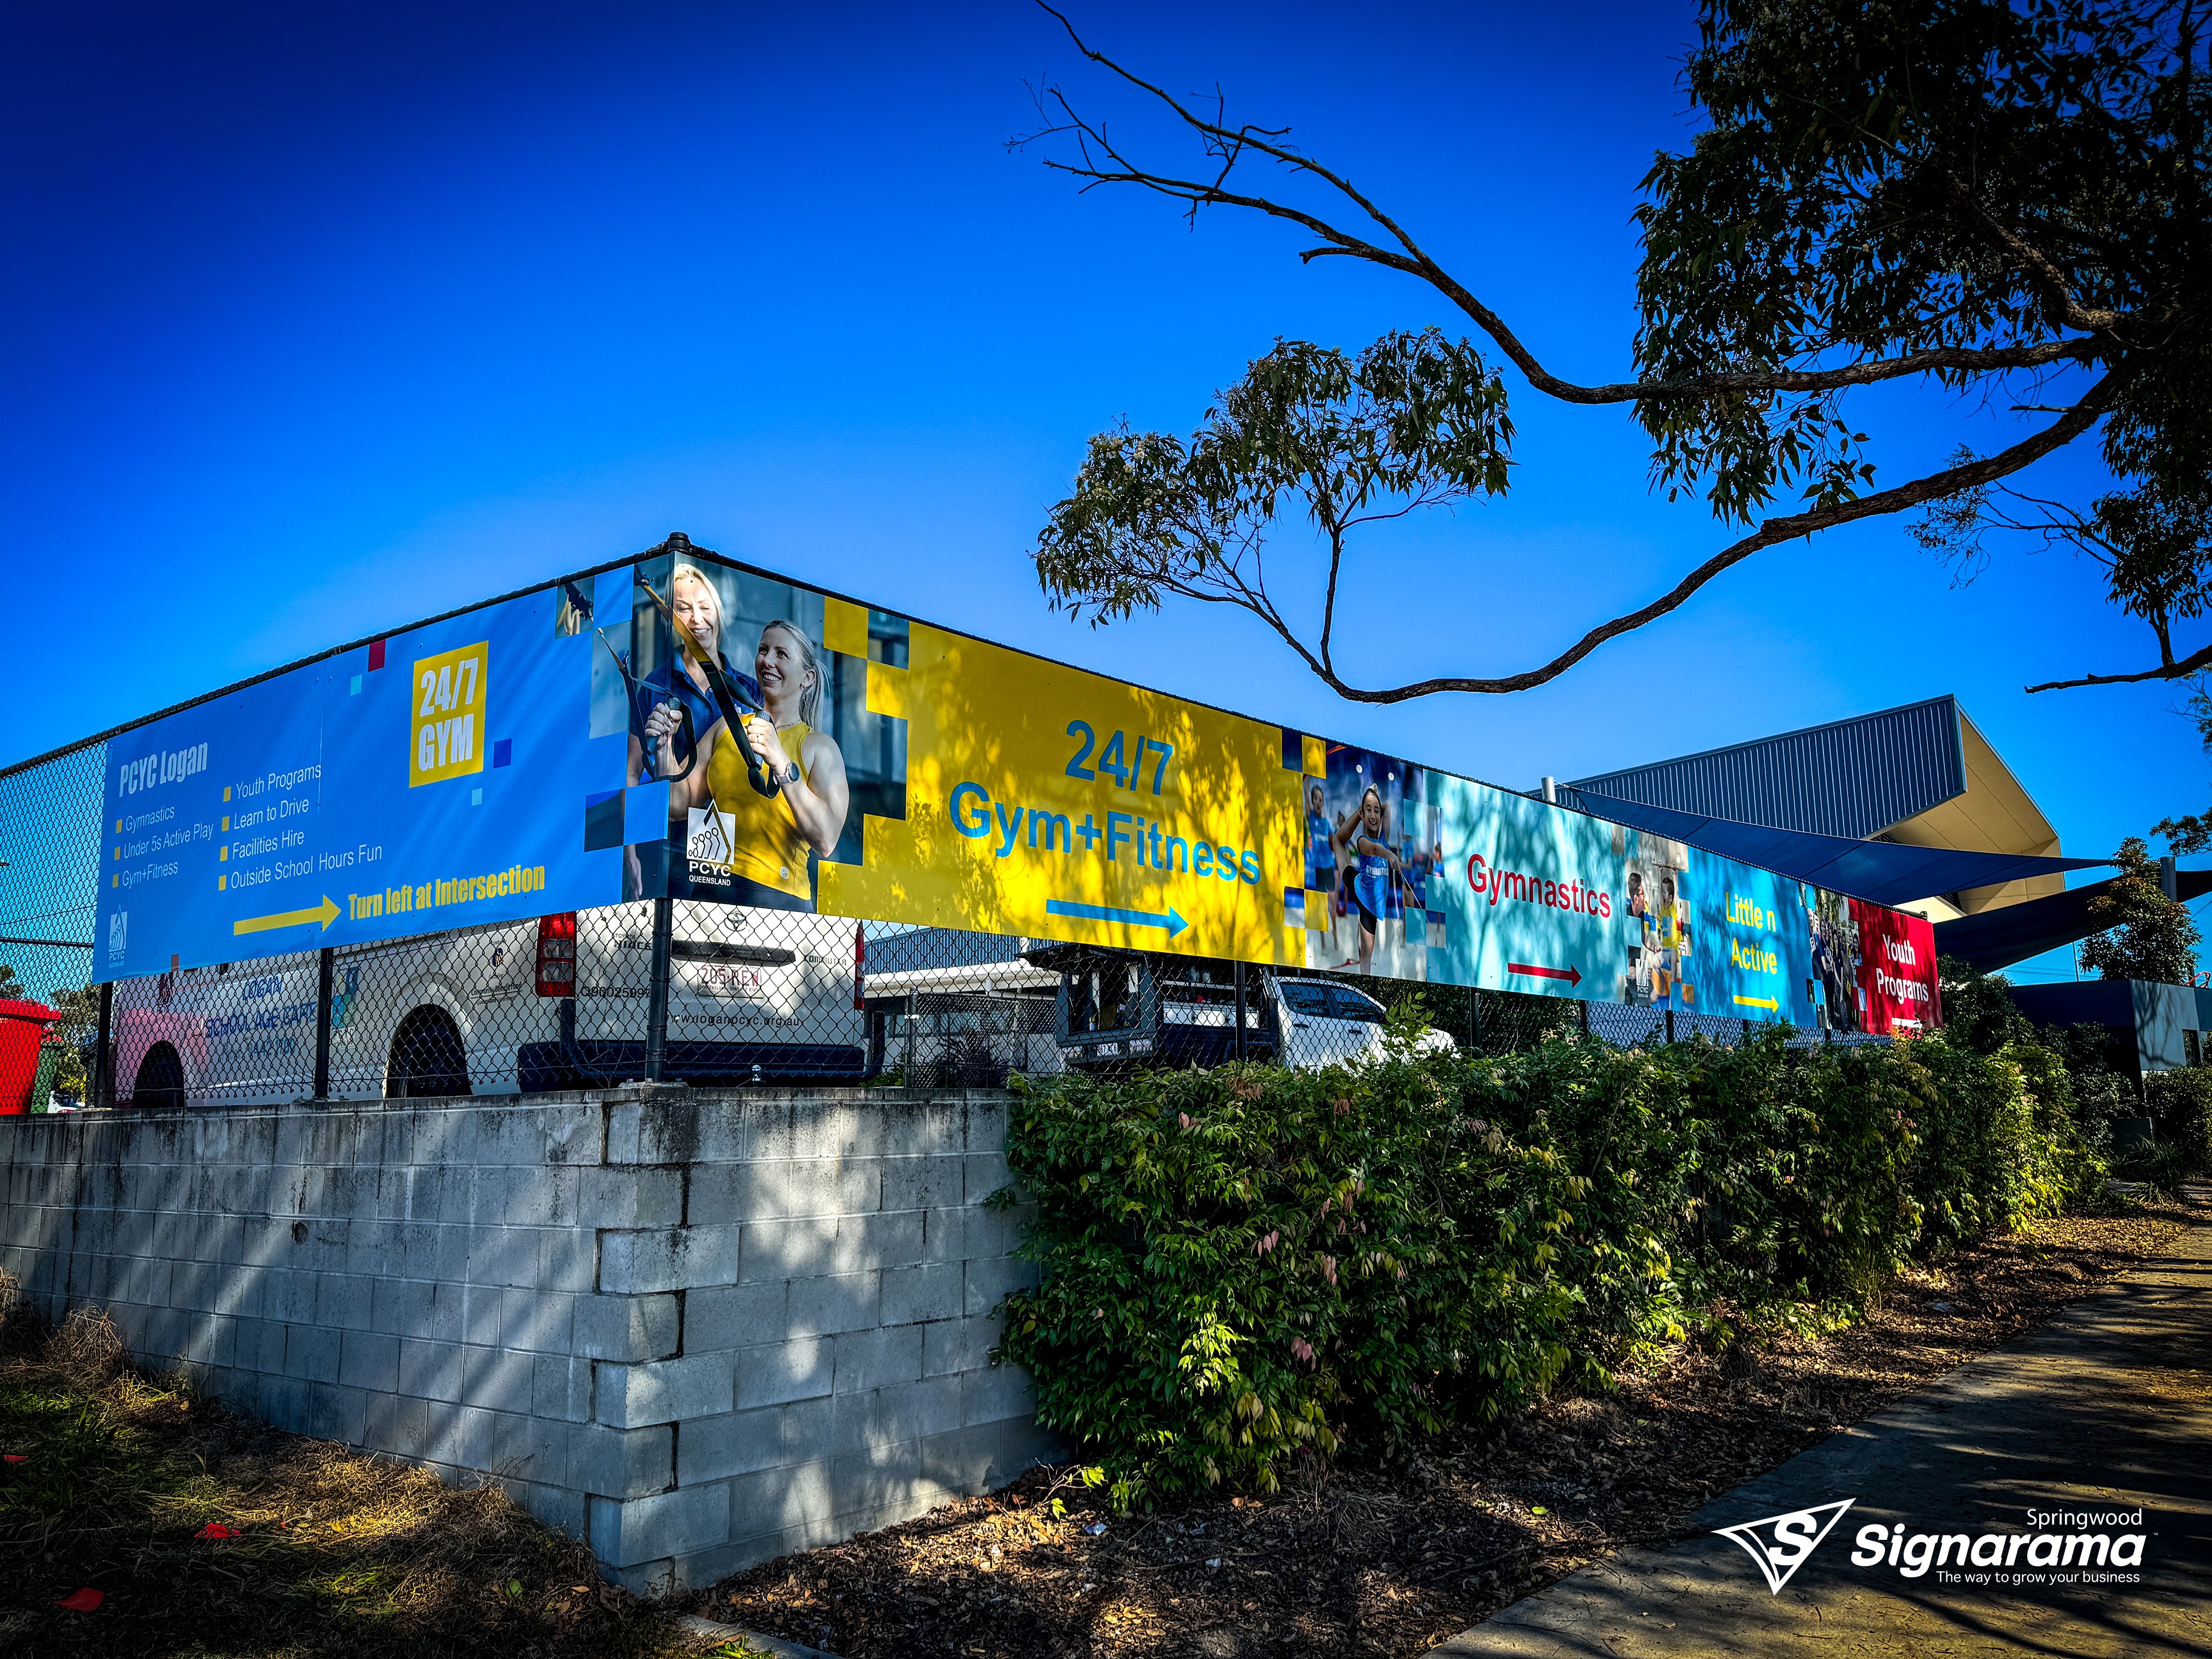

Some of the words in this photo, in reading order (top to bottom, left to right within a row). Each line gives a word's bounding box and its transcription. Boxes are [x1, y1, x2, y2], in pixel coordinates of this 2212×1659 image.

[420, 657, 478, 716] 24/7
[418, 713, 474, 771] GYM
[1065, 720, 1173, 796] 24/7
[119, 754, 157, 797] PCYC
[160, 742, 208, 784] Logan
[236, 780, 264, 799] Youth
[268, 765, 321, 792] Programs
[126, 806, 174, 832] Gymnastics
[234, 811, 263, 829] Learn
[267, 806, 276, 821] to
[280, 799, 309, 817] Drive
[124, 839, 148, 859] Under
[151, 836, 162, 852] 5s
[163, 829, 190, 848] Active
[193, 823, 214, 843] Play
[233, 836, 278, 859] Facilities
[282, 831, 304, 849] Hire
[949, 781, 1260, 885] Gym+Fitness
[122, 860, 178, 887] Gym+Fitness
[232, 867, 271, 889] Outside
[274, 856, 313, 879] School
[319, 853, 354, 871] Hours
[358, 845, 382, 863] Fun
[689, 861, 731, 877] PCYC
[689, 875, 731, 886] QUEENSLAND
[348, 894, 382, 920] Turn
[386, 885, 413, 914] left
[416, 882, 432, 907] at
[435, 865, 545, 906] Intersection
[1467, 853, 1611, 918] Gymnastics
[1725, 891, 1763, 929] Little
[1767, 910, 1776, 932] n
[109, 951, 125, 961] PCYC
[1731, 938, 1778, 975] Active
[1882, 934, 1916, 966] Youth
[242, 976, 282, 1001] LOGAN
[1876, 967, 1928, 1005] Programs
[206, 1013, 251, 1038] SCHOOL
[255, 1007, 279, 1030] AGE
